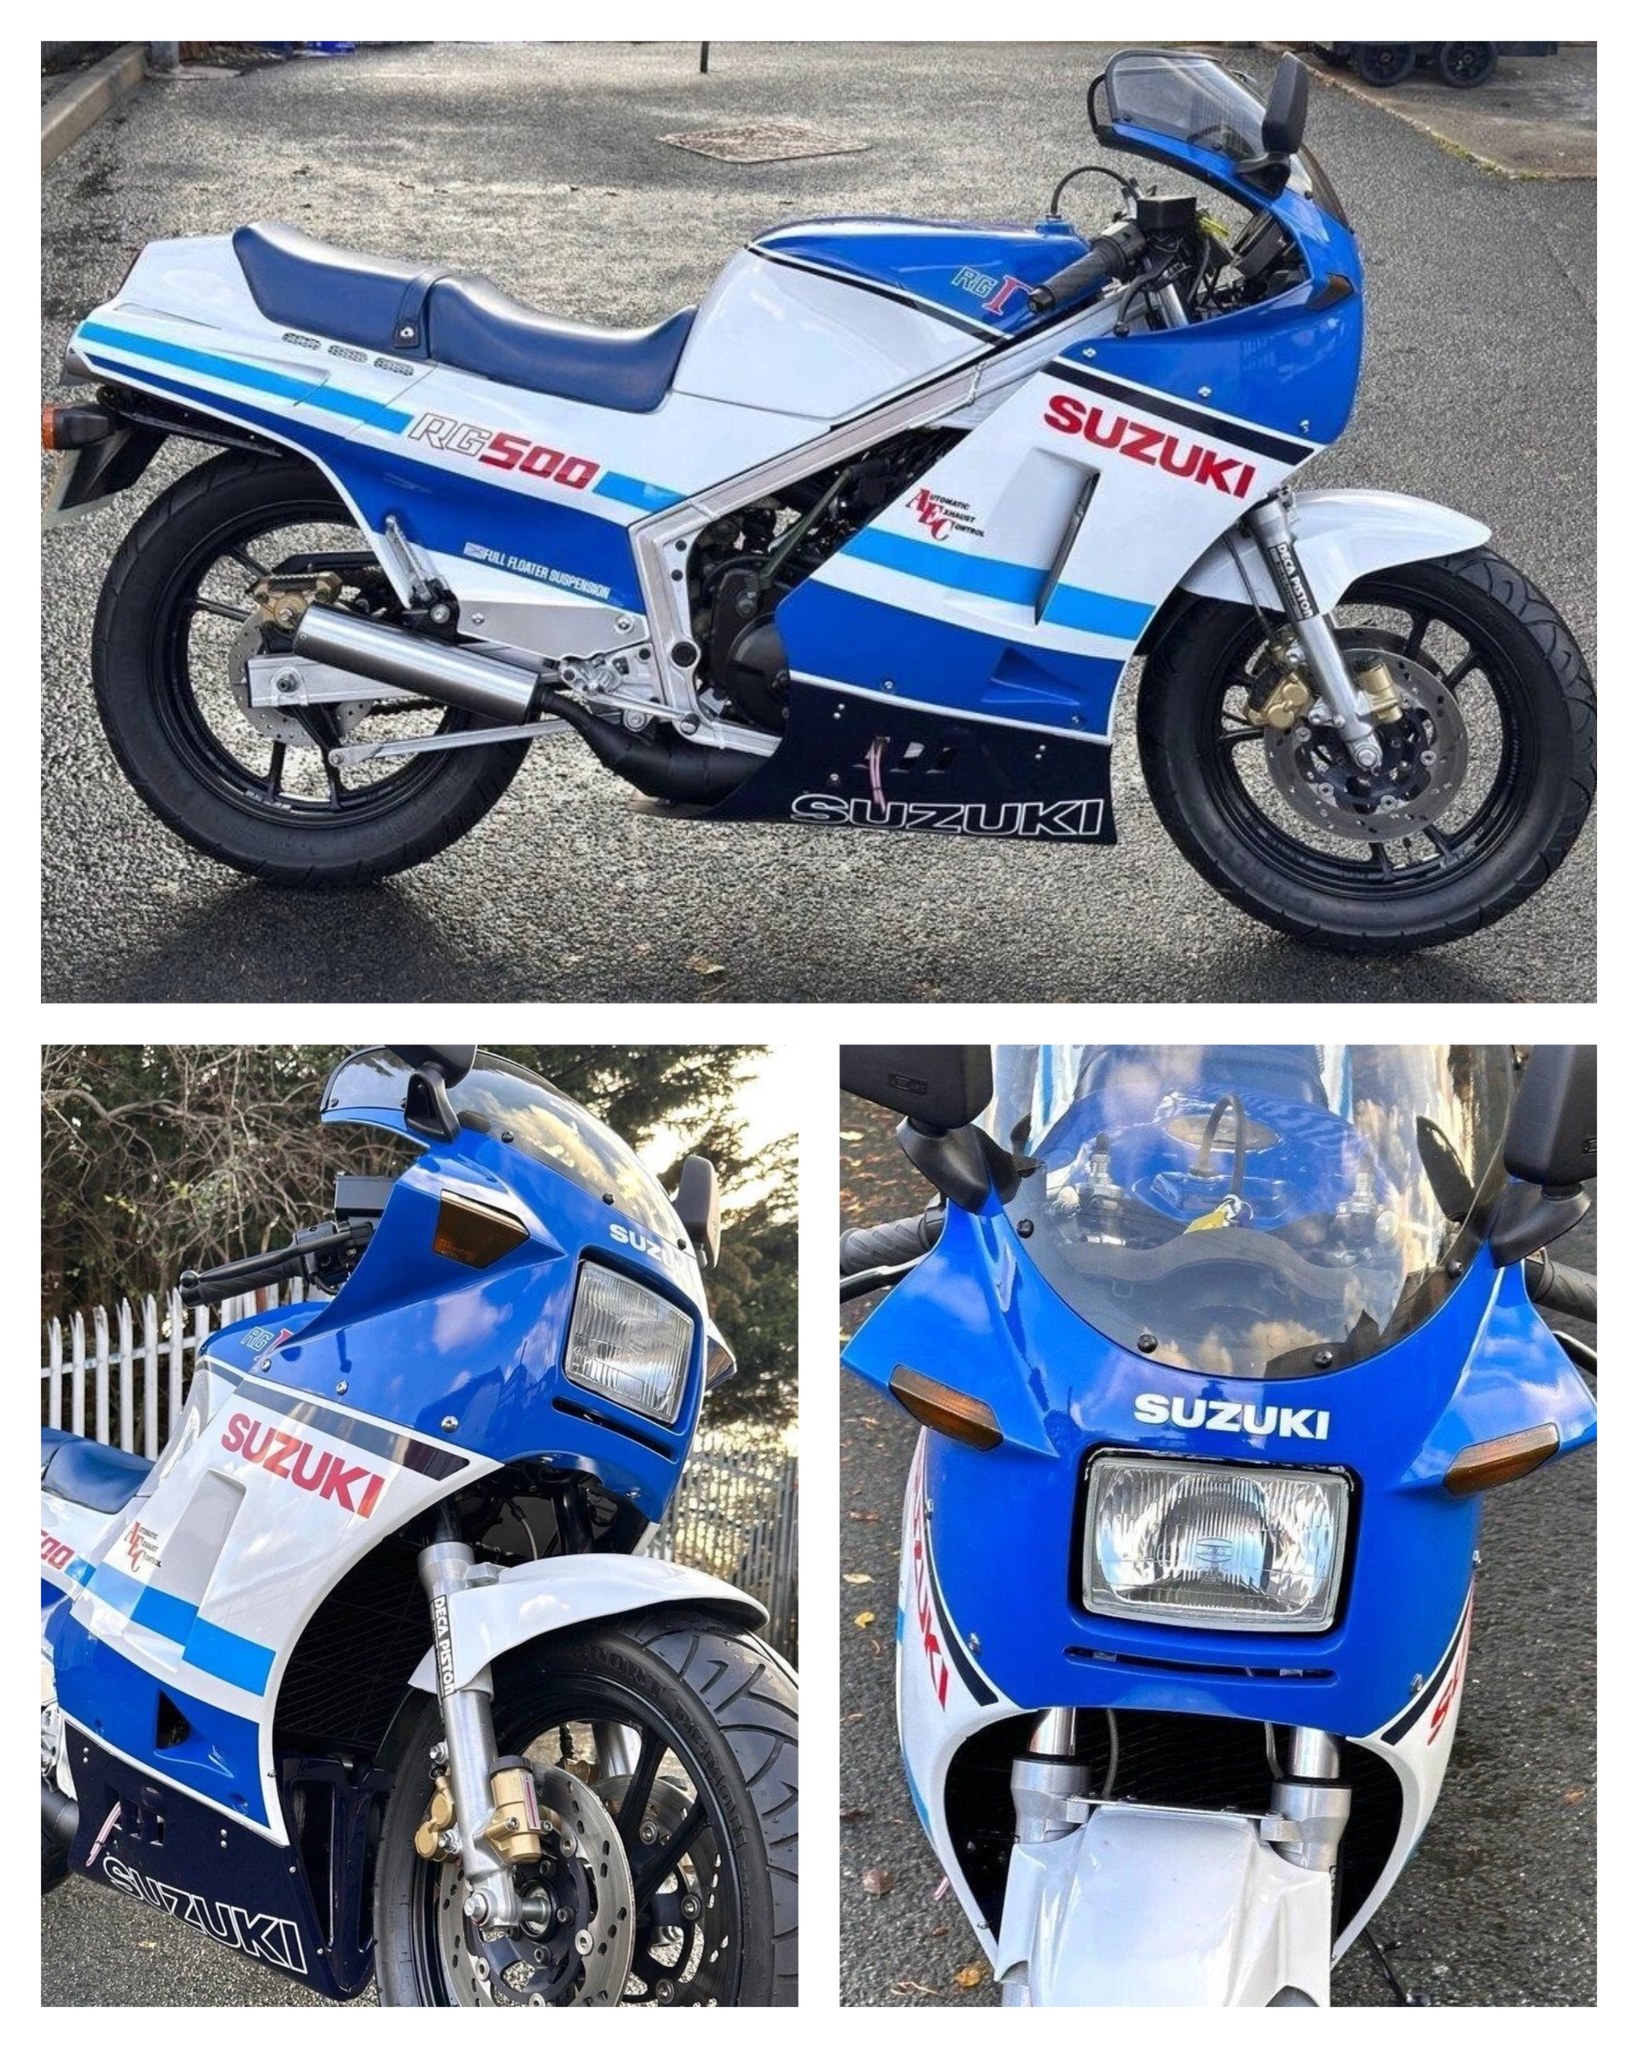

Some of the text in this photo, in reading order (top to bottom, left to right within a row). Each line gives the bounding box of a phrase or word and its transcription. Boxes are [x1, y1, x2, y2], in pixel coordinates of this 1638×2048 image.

[407, 412, 601, 490] RG500
[1043, 394, 1256, 499] SUZUKI
[482, 548, 612, 600] FULL FLOATER SUSPENSION
[1276, 543, 1297, 578] DECA
[790, 793, 1104, 836] SUZUKI
[1133, 1393, 1330, 1440] SUZUKI
[221, 1412, 386, 1519] SUZUKI
[433, 1597, 455, 1696] DECA PISTON
[103, 1855, 308, 1975] SUZUKI
